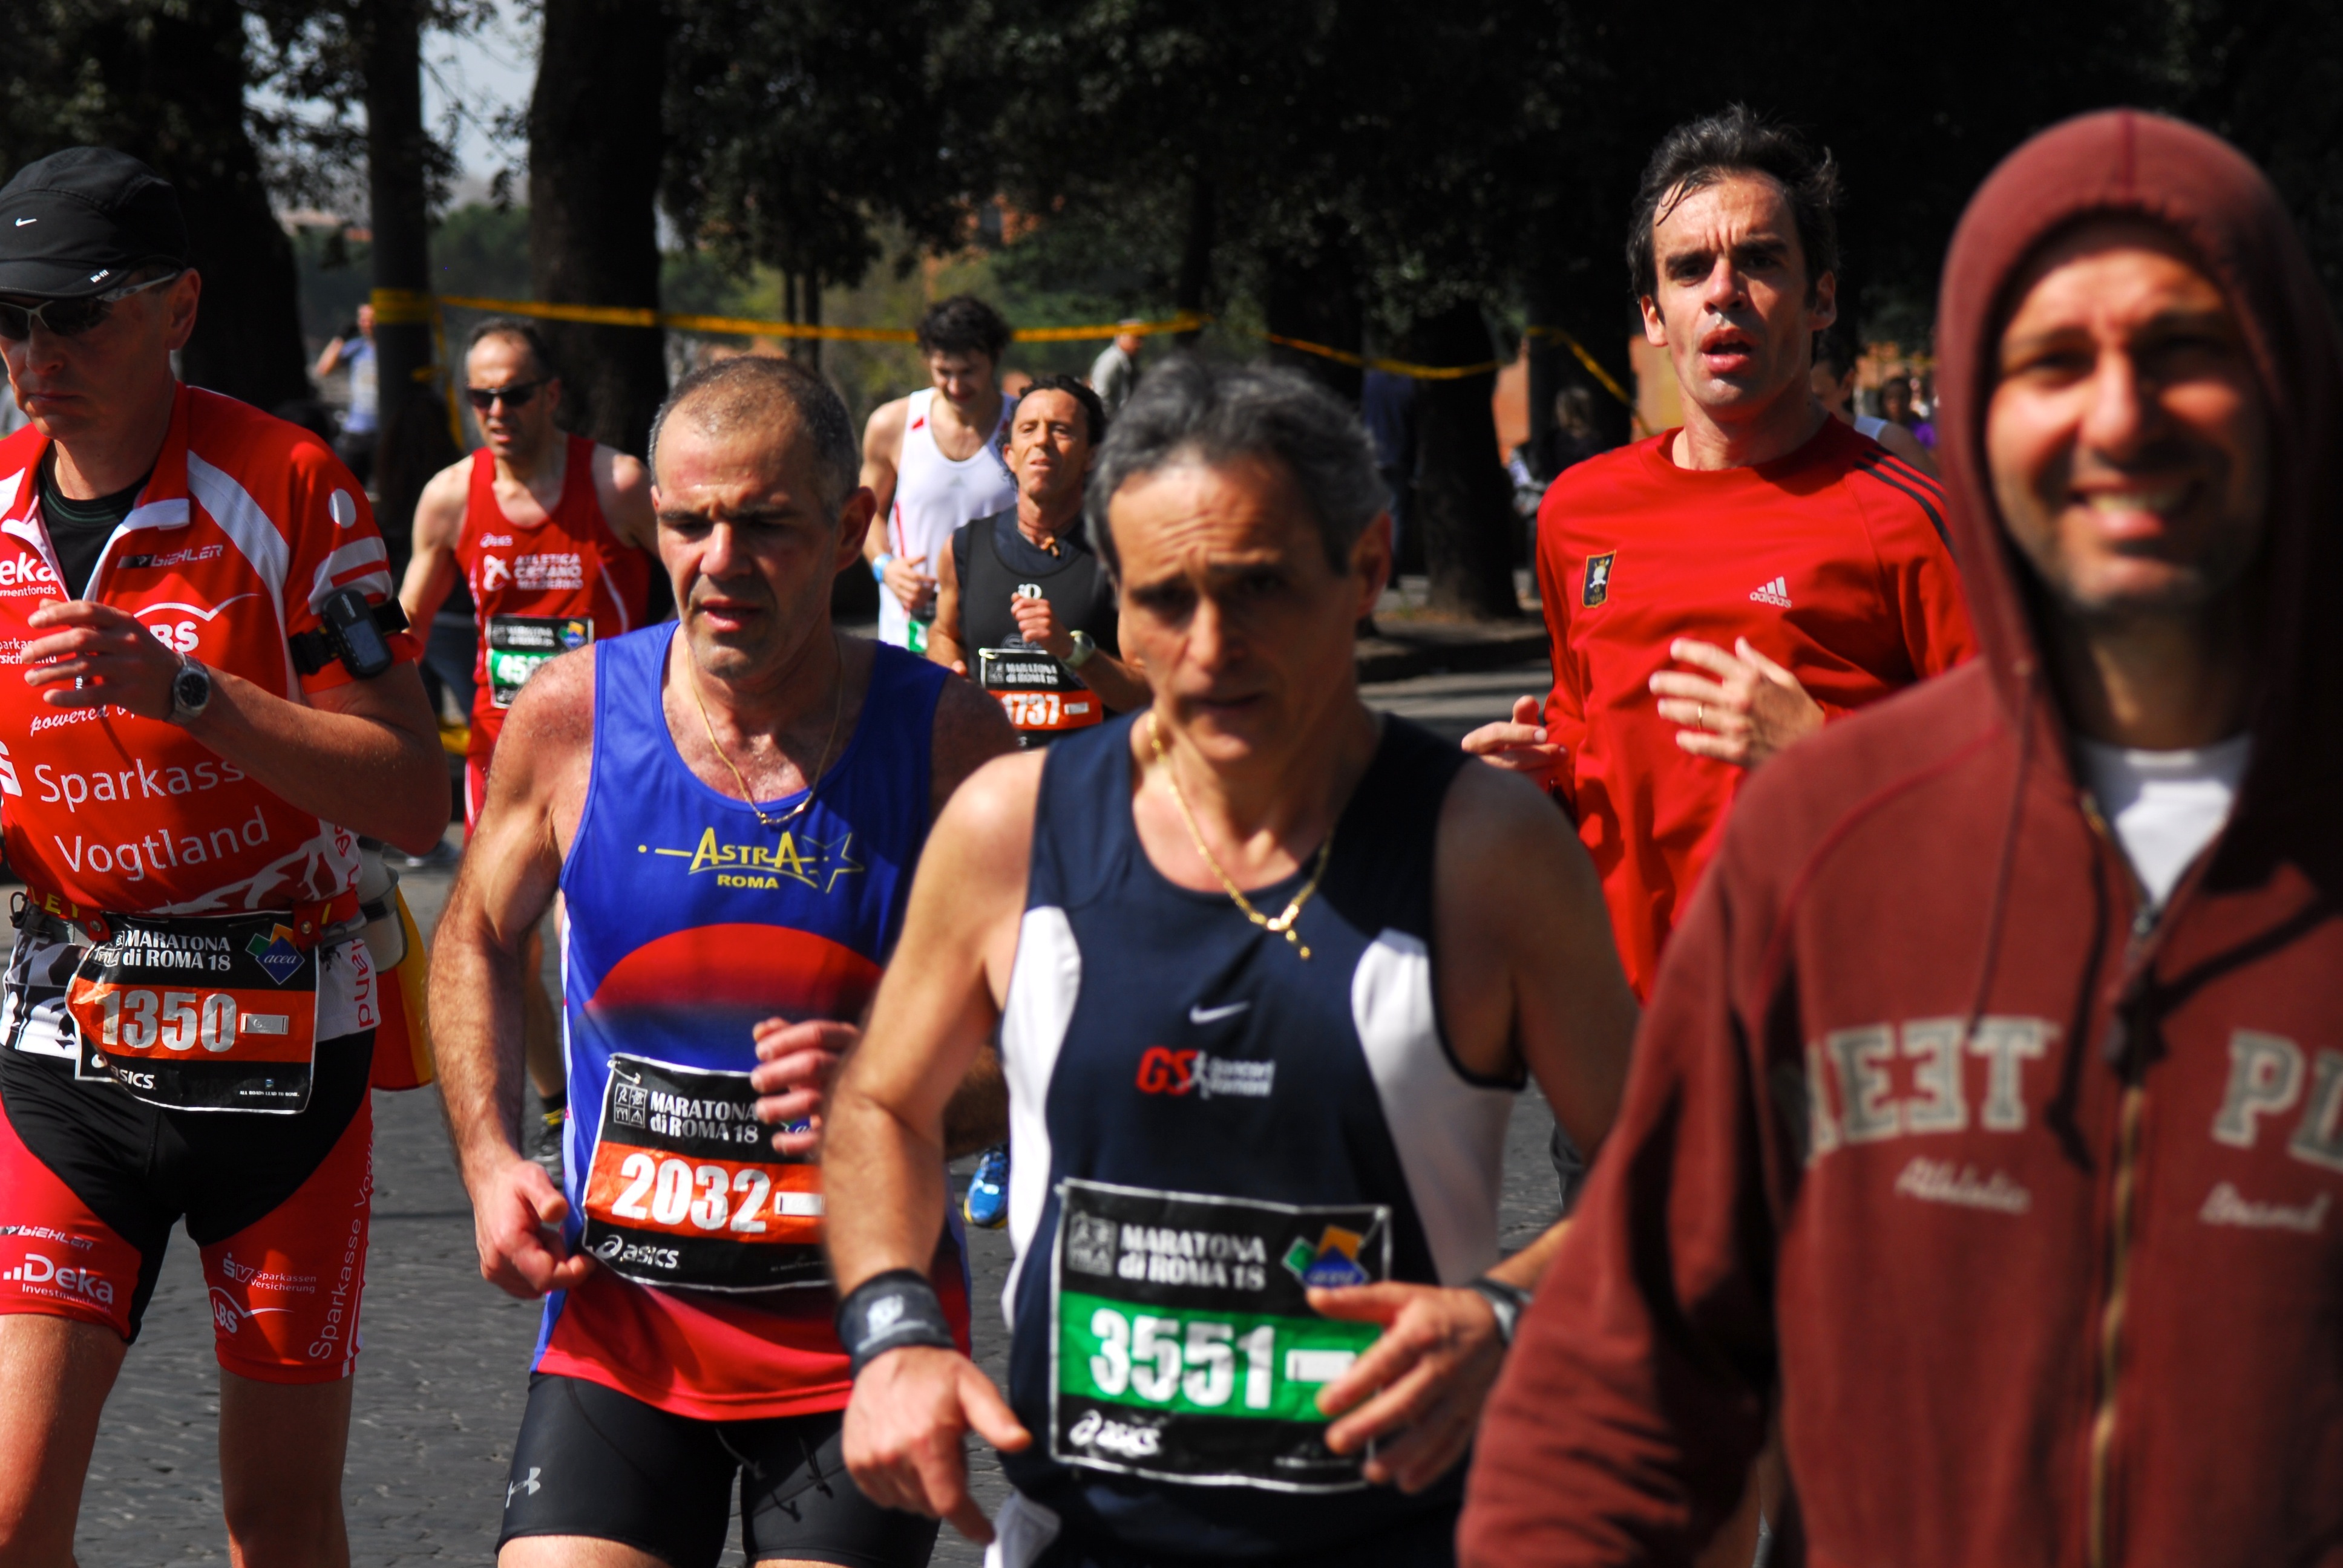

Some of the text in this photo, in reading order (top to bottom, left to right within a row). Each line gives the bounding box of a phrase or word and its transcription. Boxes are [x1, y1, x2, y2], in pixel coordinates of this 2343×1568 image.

[0, 552, 58, 585] eka
[1749, 591, 1792, 609] adidas
[149, 621, 199, 652] BS
[30, 705, 110, 737] powered
[1002, 694, 1060, 725] 1737
[34, 759, 245, 812] Sparkass
[54, 806, 270, 881] Vogtland
[717, 874, 779, 889] ROMA
[125, 930, 231, 952] MARATONA
[122, 950, 231, 971] di ROMA 18
[264, 953, 297, 965] acea
[95, 990, 237, 1053] 1350
[650, 1091, 759, 1122] MARATONA
[650, 1114, 759, 1144] di ROMA 18
[611, 1153, 770, 1234] 2032
[1119, 1224, 1266, 1264] MARATONA
[23, 1253, 114, 1305] Deka
[251, 1279, 315, 1293] Versicherung
[257, 1270, 316, 1282] Sparkassen
[1118, 1253, 1266, 1291] di ROMA 18
[309, 1218, 362, 1359] Sparkasse
[214, 1297, 237, 1334] LBS
[1090, 1307, 1274, 1410] 3551
